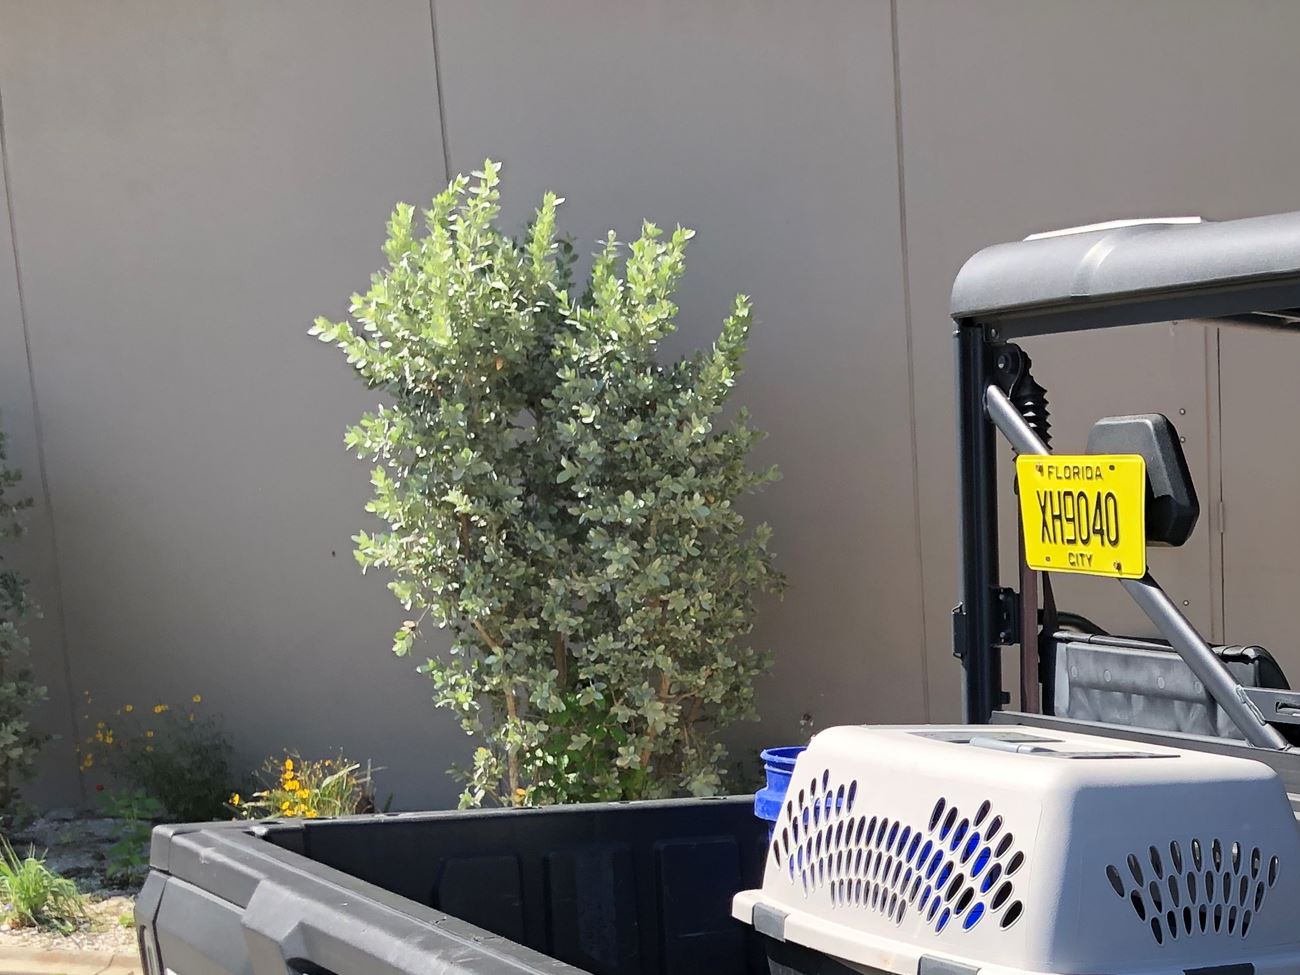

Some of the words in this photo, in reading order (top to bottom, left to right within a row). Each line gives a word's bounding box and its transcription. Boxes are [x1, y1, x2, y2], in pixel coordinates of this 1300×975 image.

[1047, 465, 1104, 480] FLORIDA
[1036, 490, 1120, 547] XH9040
[1068, 552, 1094, 567] CITY
